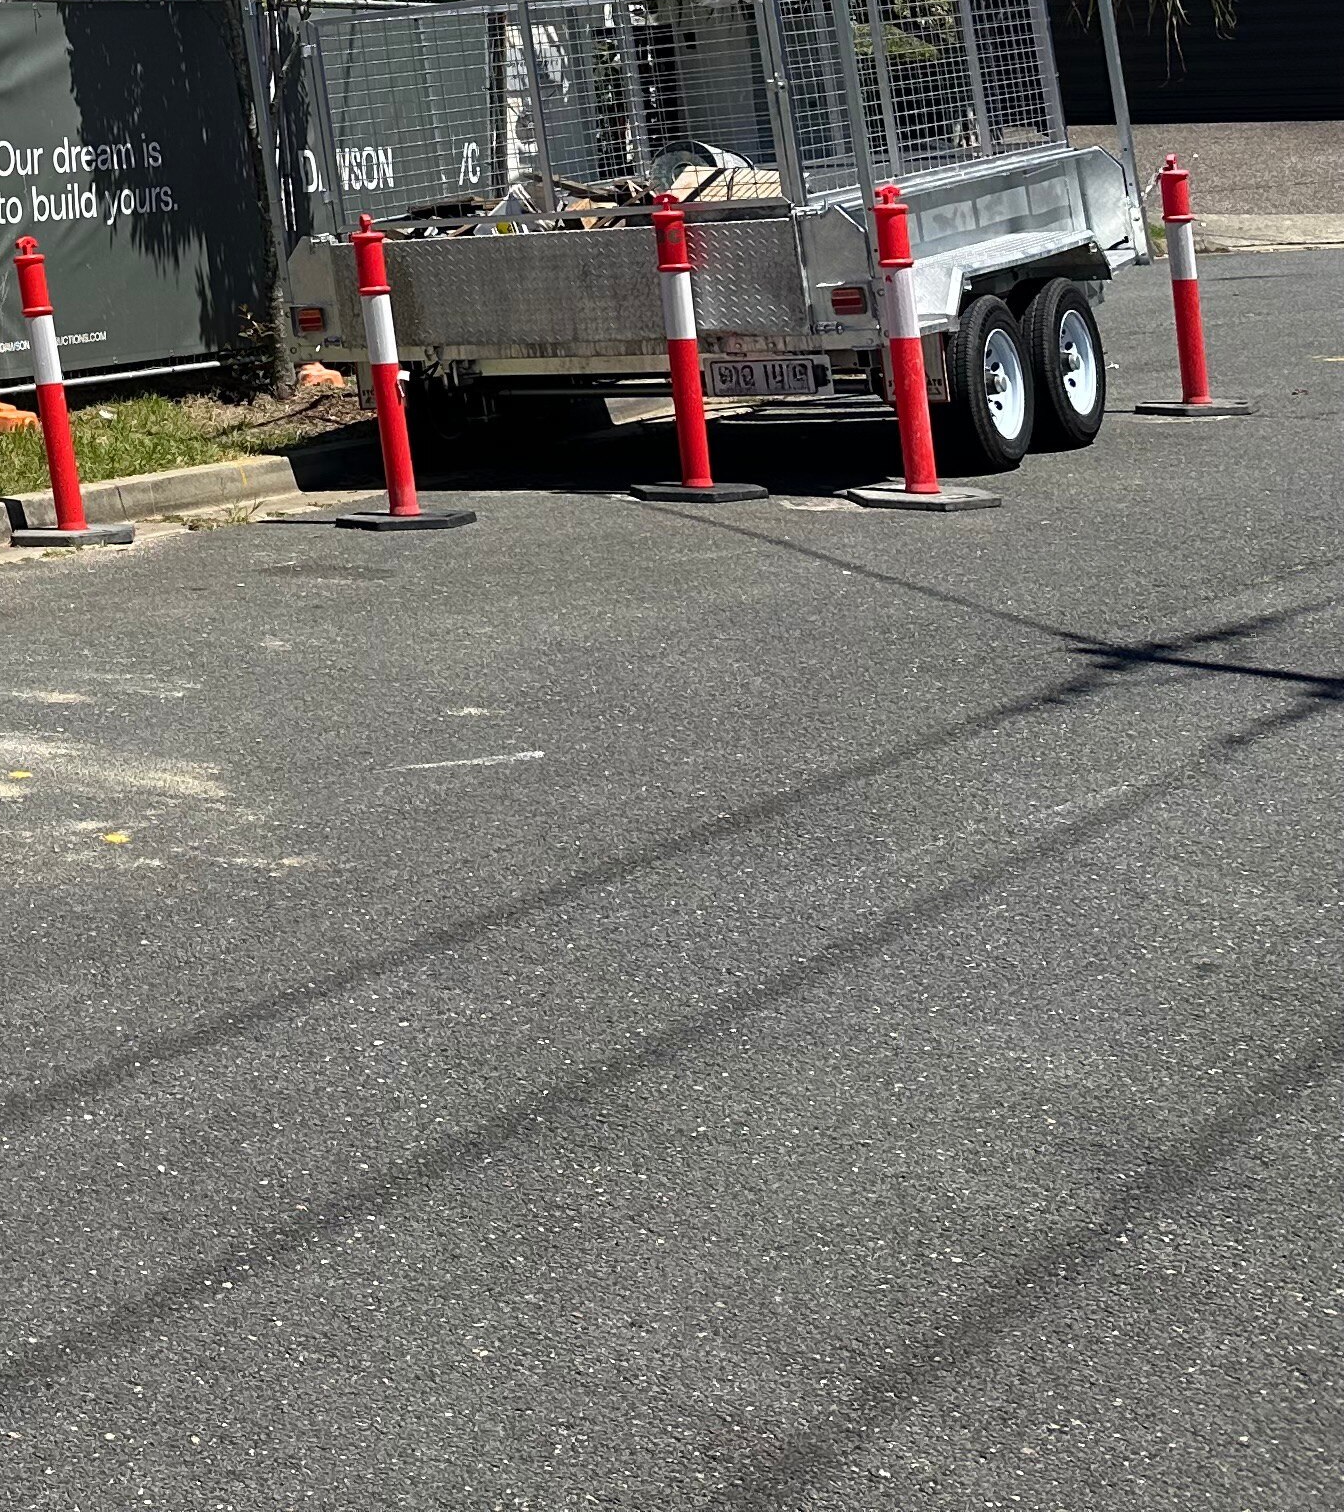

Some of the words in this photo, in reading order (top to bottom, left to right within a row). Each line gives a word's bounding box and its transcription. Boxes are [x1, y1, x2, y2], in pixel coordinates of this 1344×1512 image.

[52, 135, 135, 174] dream
[142, 134, 162, 168] is
[302, 147, 394, 193] DWSON
[33, 182, 97, 222] build
[106, 184, 178, 227] yours.
